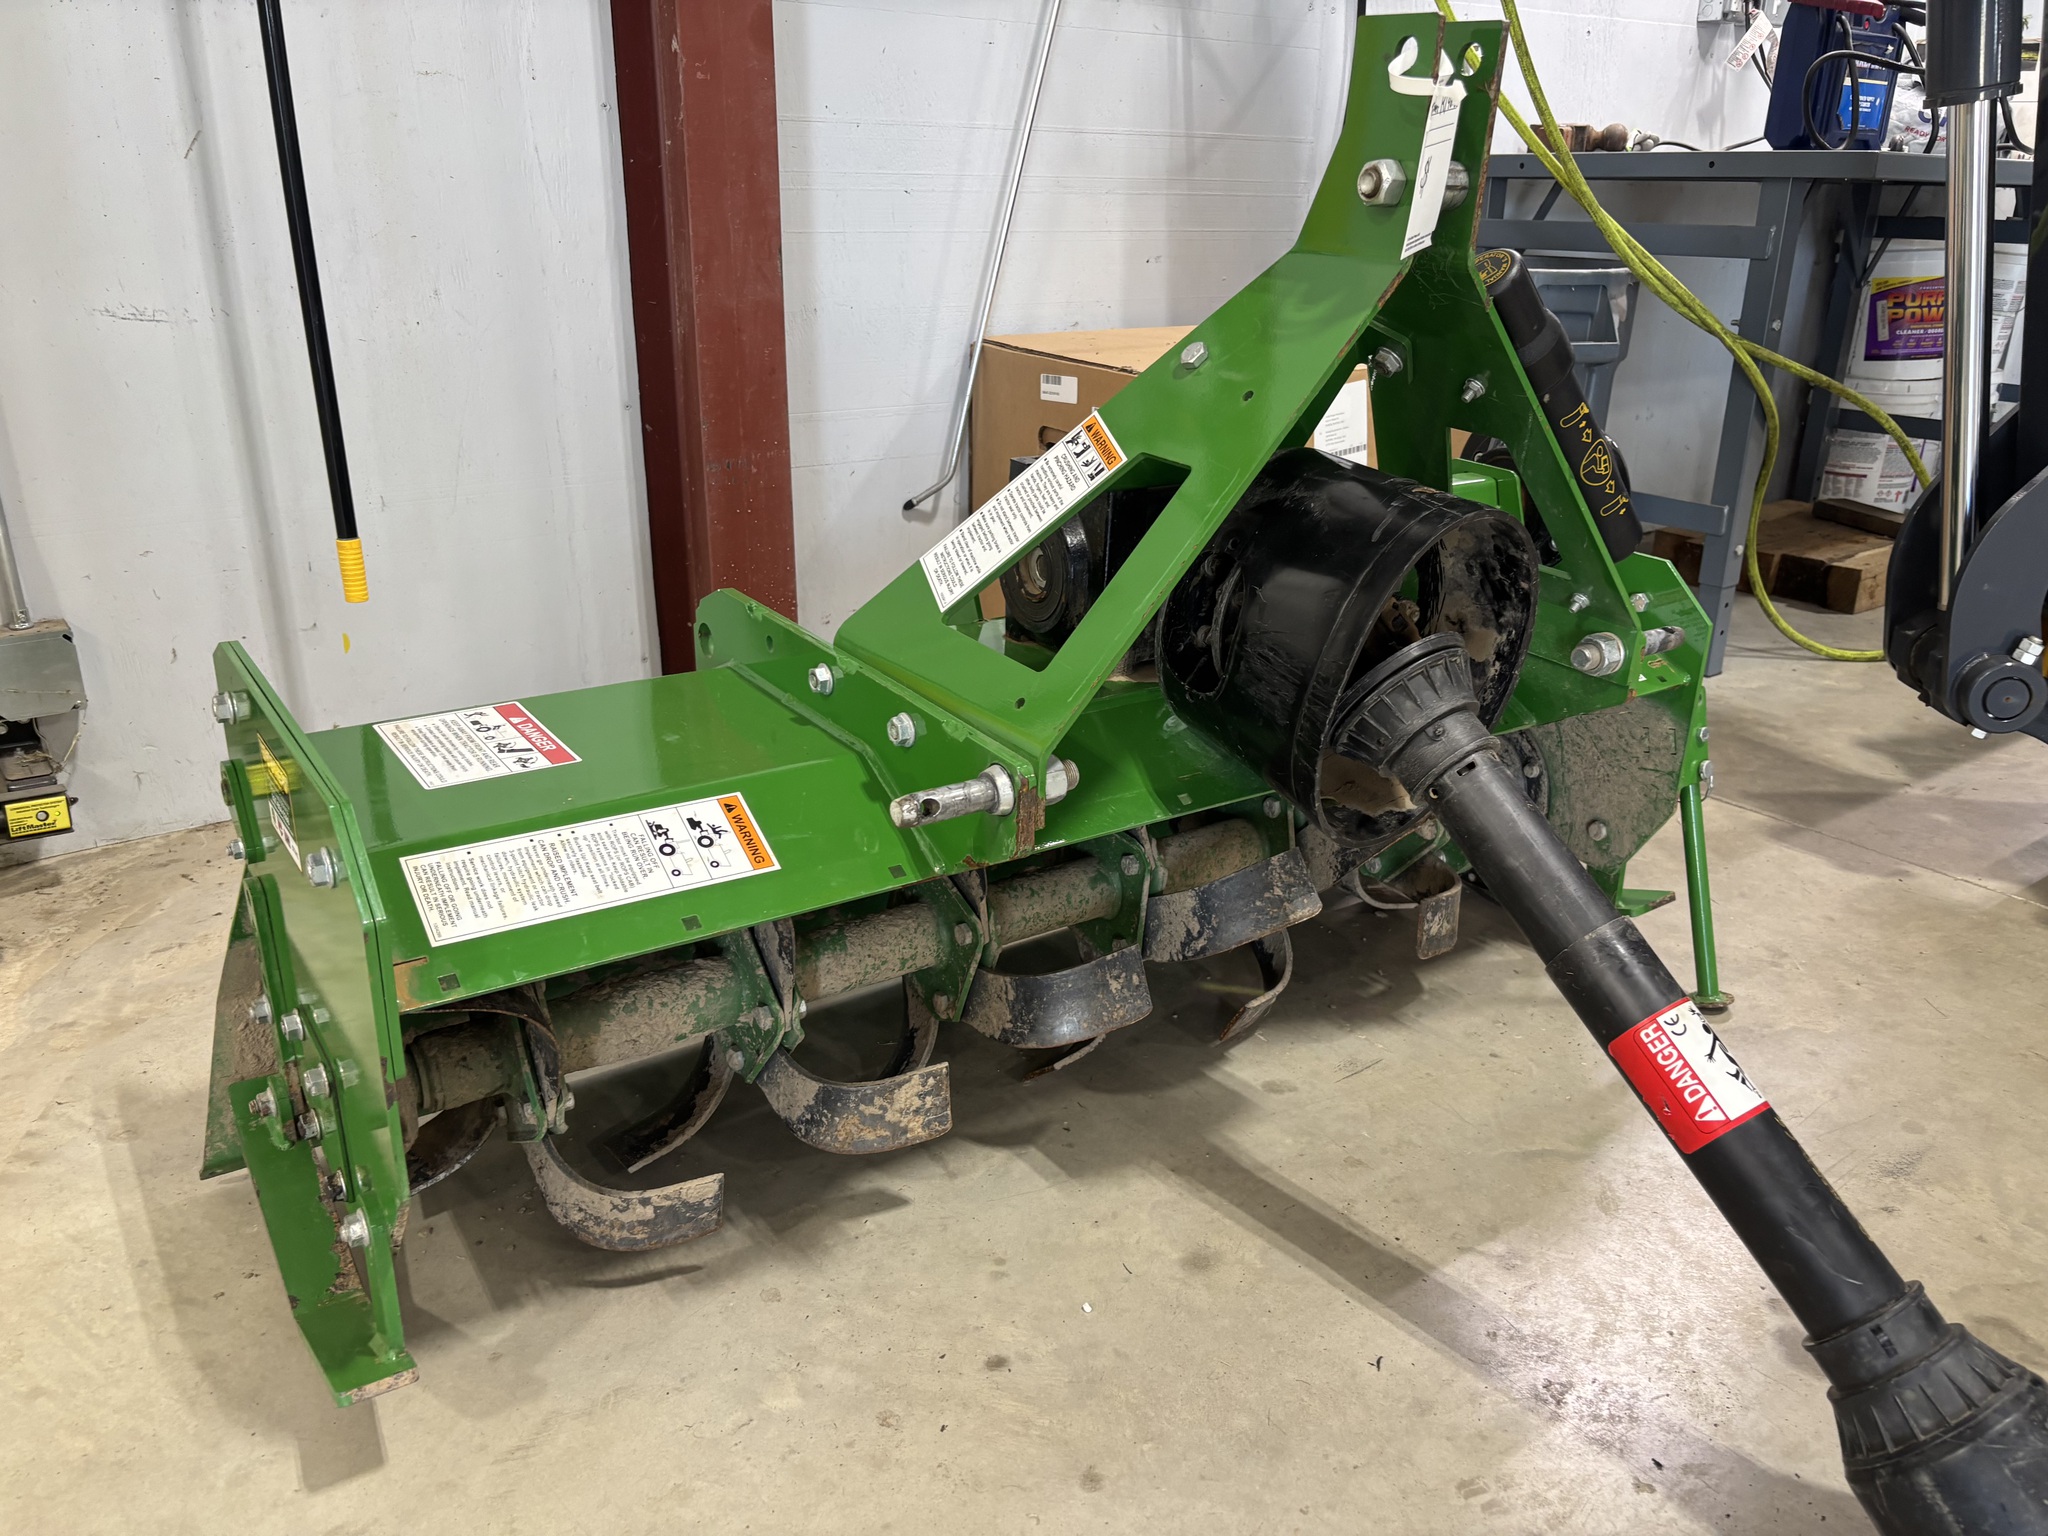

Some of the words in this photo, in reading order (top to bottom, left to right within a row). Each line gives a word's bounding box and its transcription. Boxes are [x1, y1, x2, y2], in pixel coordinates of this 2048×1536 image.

[1904, 125, 1930, 138] READY
[1888, 307, 1945, 323] POW
[1089, 427, 1117, 466] WARNING
[515, 722, 558, 752] DANGER
[11, 821, 56, 833] LiftMaster
[730, 813, 766, 864] WARNING
[620, 830, 634, 849] BEING
[629, 848, 640, 862] RUN
[628, 832, 640, 845] CAN
[635, 844, 651, 866] RESULT
[645, 866, 654, 874] IN
[637, 833, 653, 857] FALLING
[648, 857, 660, 869] OFF
[419, 863, 429, 876] CAN
[434, 860, 448, 883] FALLING
[536, 838, 548, 852] CAN
[542, 851, 555, 869] DROP
[549, 868, 561, 882] AND
[548, 841, 563, 864] RAISED
[557, 863, 578, 897] IMPLEMENT
[411, 864, 424, 884] INJURY
[419, 884, 428, 893] OR
[424, 875, 437, 896] RESULT
[443, 882, 452, 894] OFF
[426, 861, 446, 897] UNDERNEATH
[440, 897, 457, 928] IMPLEMENT
[431, 895, 439, 903] IN
[447, 893, 455, 903] OR
[434, 902, 448, 927] SERIOUS
[450, 902, 462, 921] GOING
[1640, 1023, 1711, 1104] DANGER
